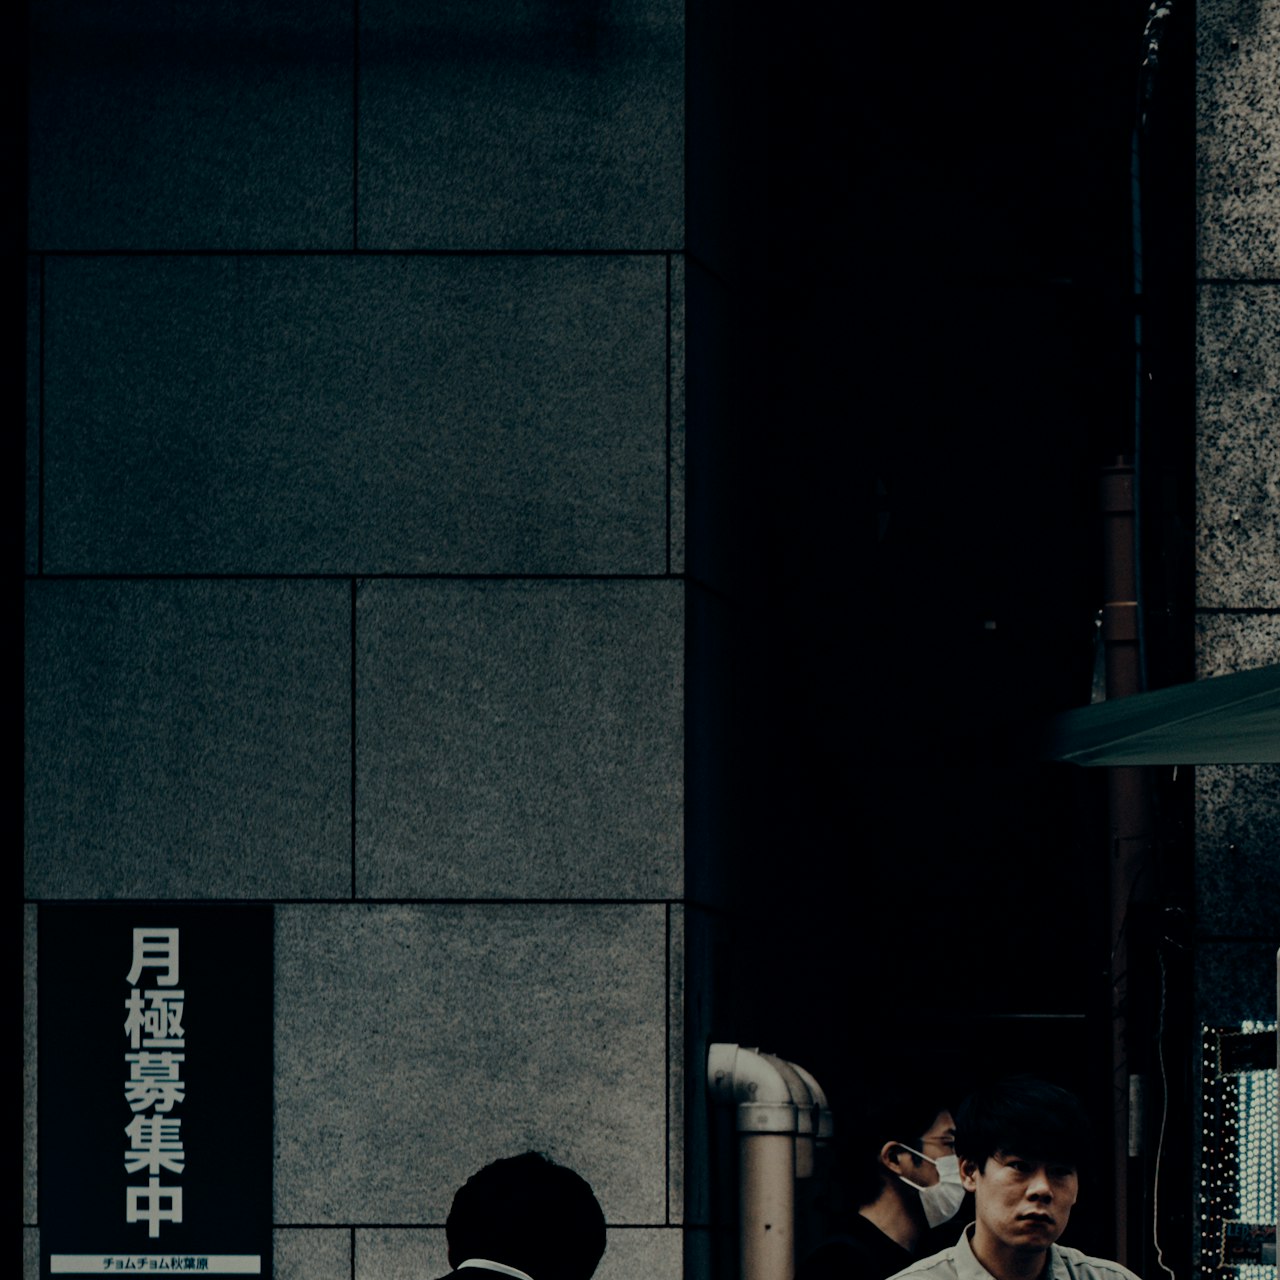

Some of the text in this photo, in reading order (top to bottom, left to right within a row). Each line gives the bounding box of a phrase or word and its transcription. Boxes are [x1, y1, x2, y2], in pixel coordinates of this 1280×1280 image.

[123, 927, 187, 1239] 月極募集中
[103, 1257, 209, 1271] チョムチョム秋葉原
